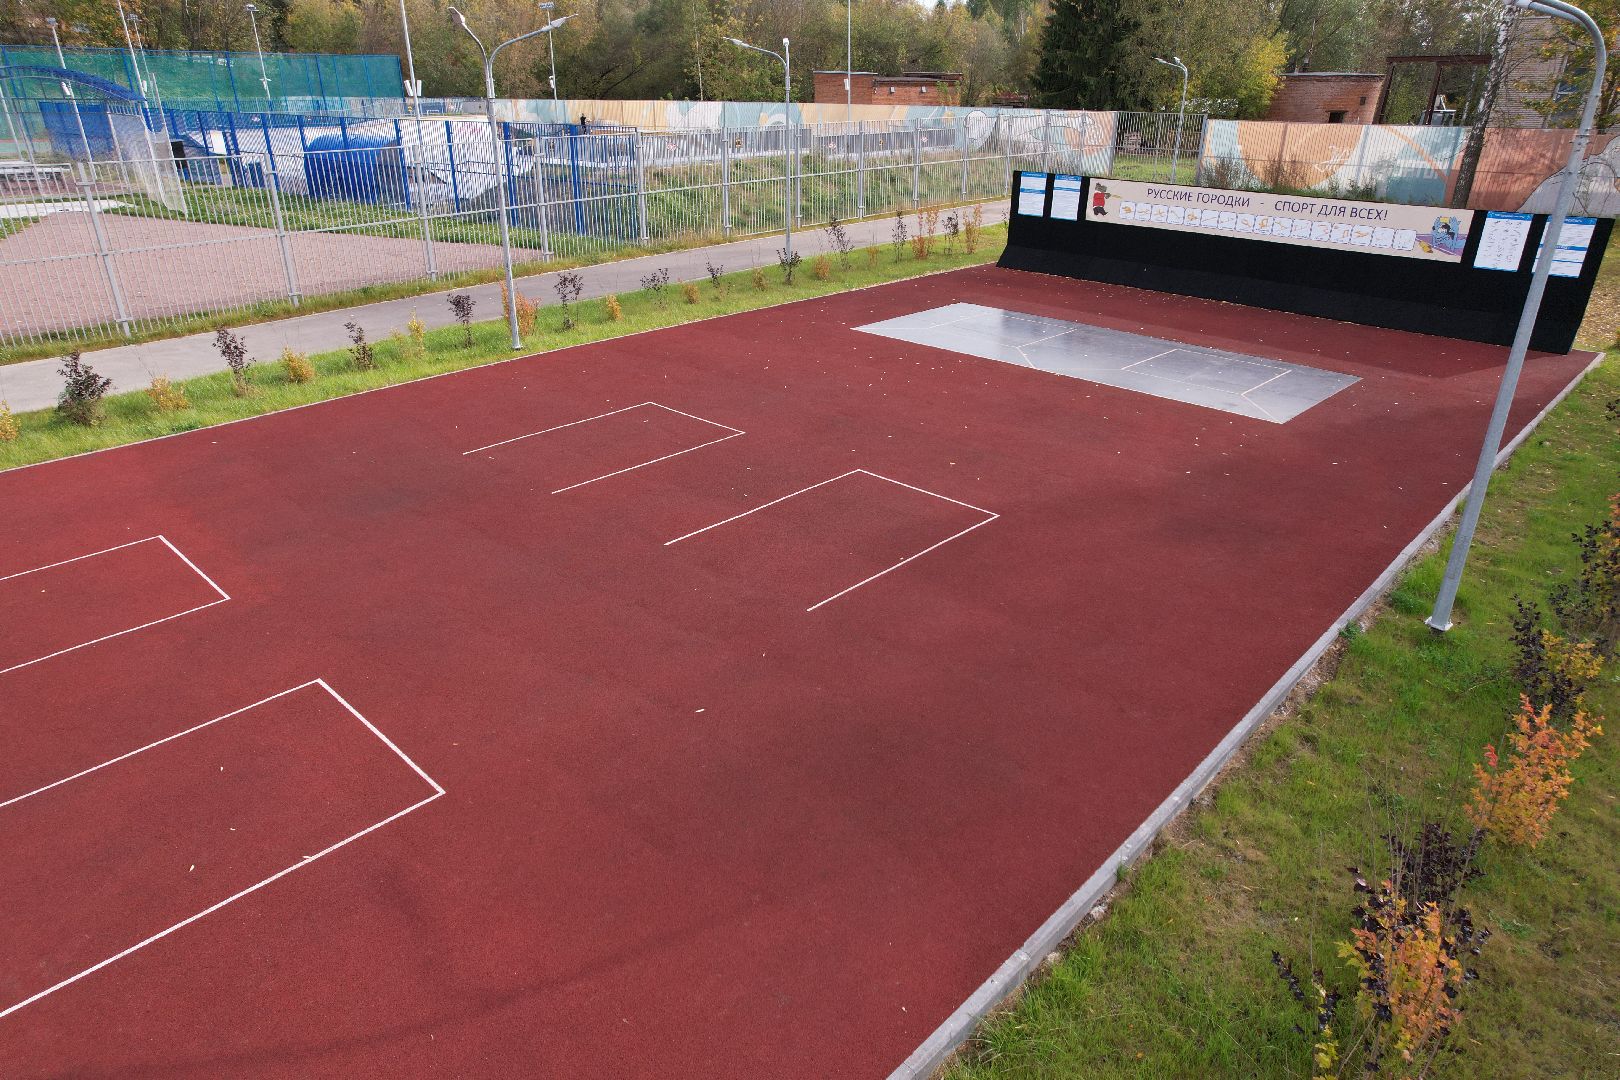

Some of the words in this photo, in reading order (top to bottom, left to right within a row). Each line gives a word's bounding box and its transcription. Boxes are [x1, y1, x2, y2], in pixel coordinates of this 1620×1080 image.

[1147, 188, 1193, 202] РУССКИЕ
[1196, 192, 1250, 208] ГОРОДКИ
[1274, 200, 1316, 214] СПОРТ
[1317, 204, 1346, 217] ДЛЯ
[1349, 207, 1388, 220] ВСЕХ!
